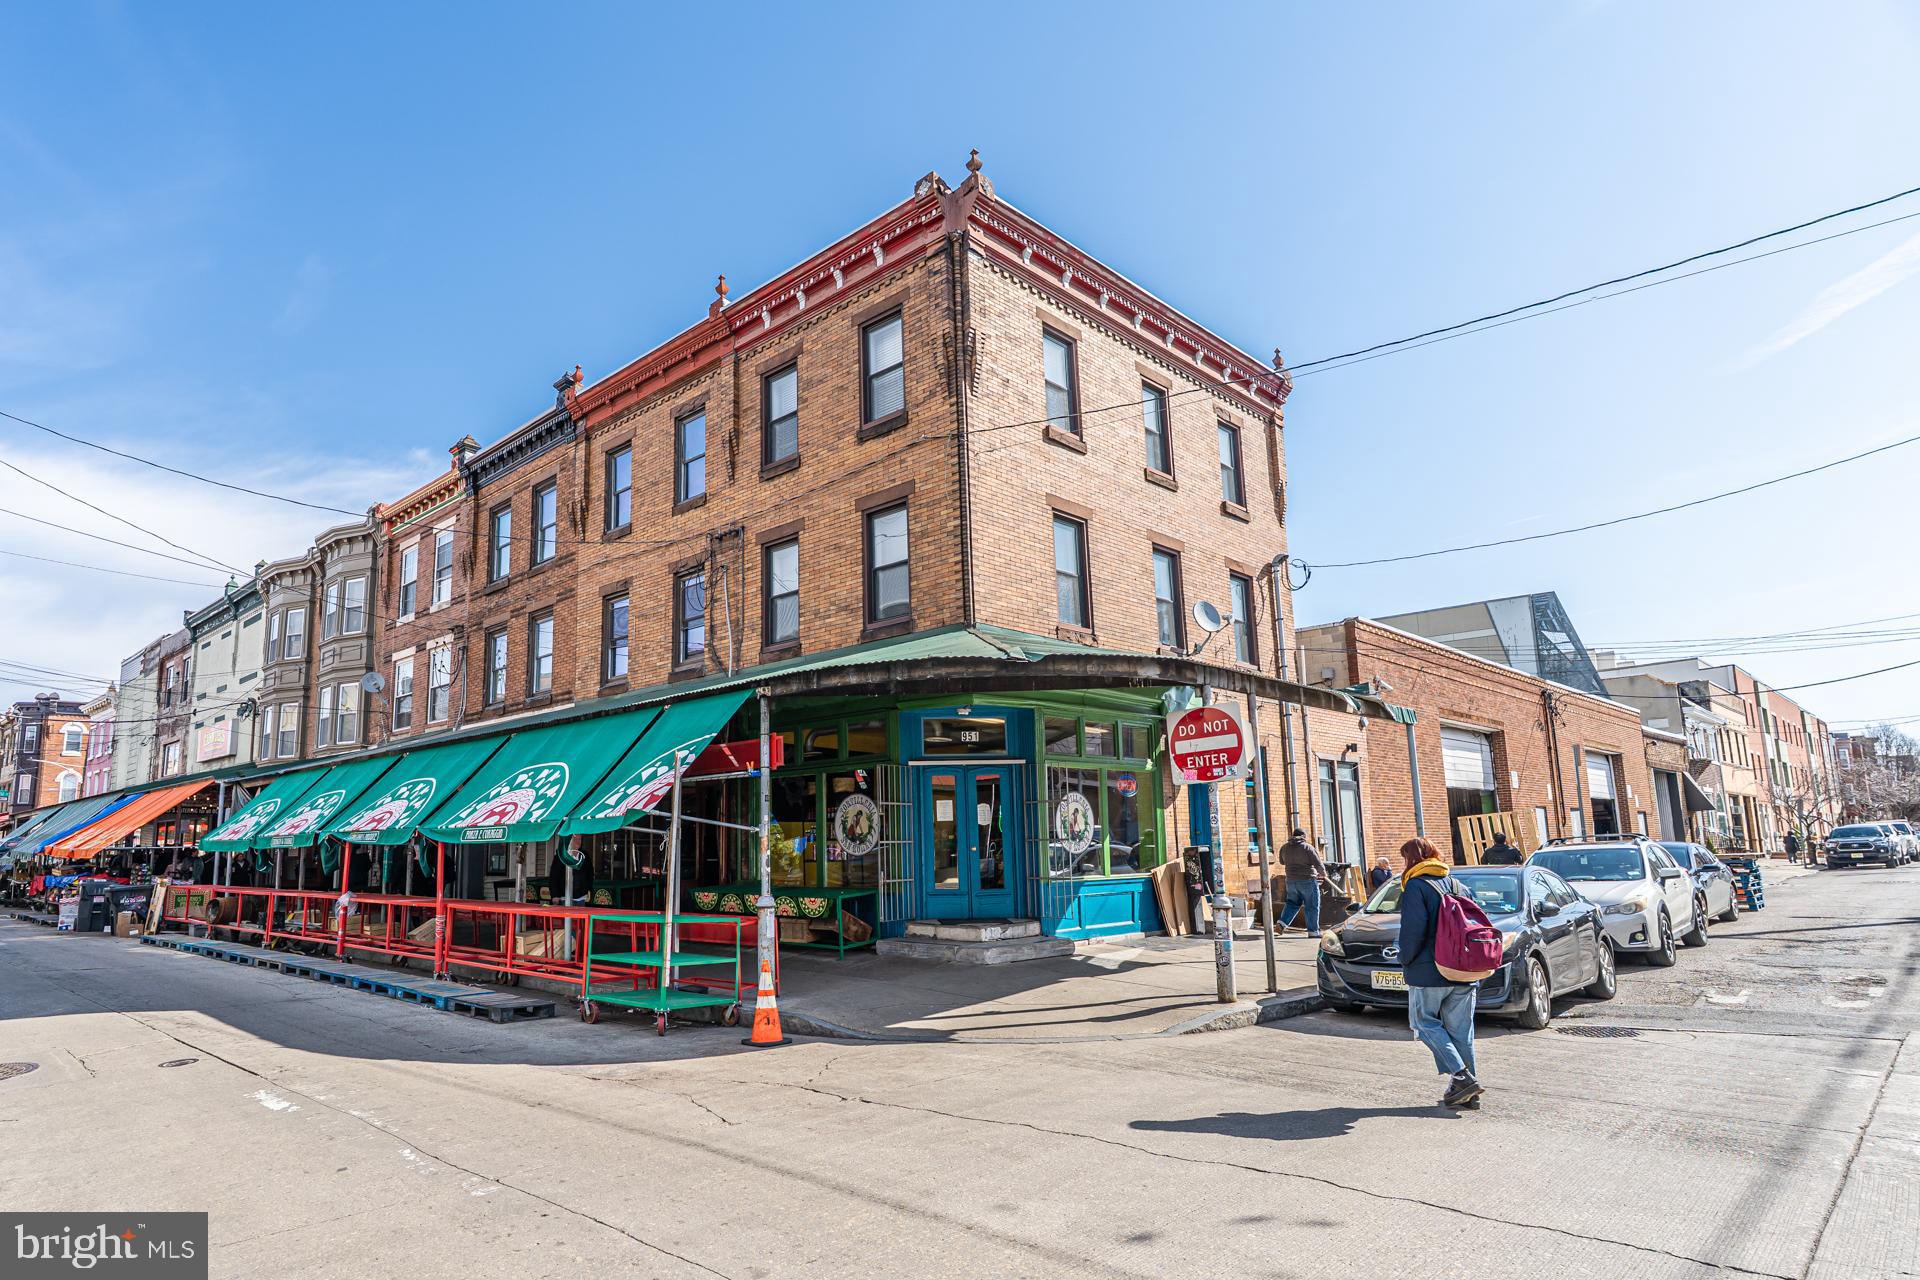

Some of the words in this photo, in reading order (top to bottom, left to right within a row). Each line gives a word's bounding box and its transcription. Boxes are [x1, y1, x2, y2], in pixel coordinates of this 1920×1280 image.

[1179, 724, 1196, 737] DO
[1203, 719, 1229, 733] NOT
[962, 731, 979, 741] 951
[1187, 753, 1229, 769] ENTER
[1116, 779, 1137, 792] OPEN
